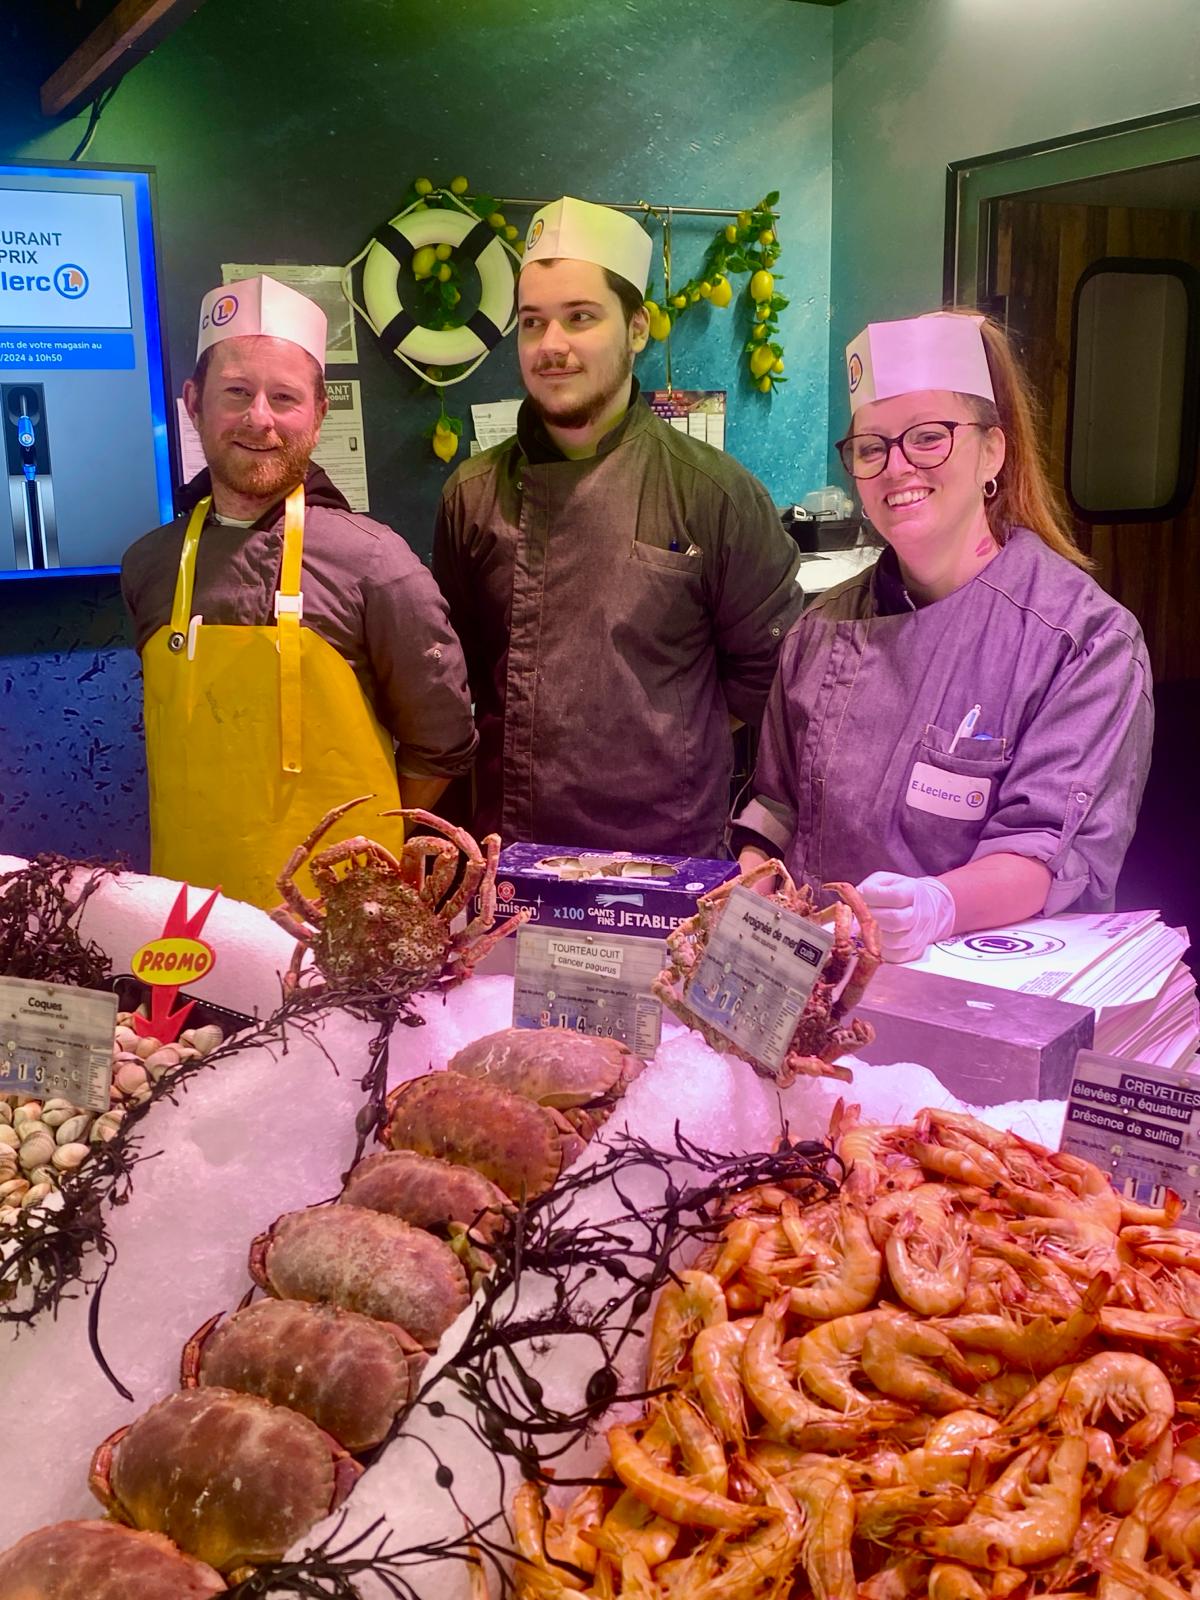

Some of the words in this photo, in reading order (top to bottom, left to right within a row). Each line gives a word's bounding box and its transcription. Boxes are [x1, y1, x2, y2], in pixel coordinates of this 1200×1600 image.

[0, 249, 38, 264] PRIX
[16, 340, 28, 349] de
[28, 341, 53, 349] votre
[54, 341, 90, 352] magasin
[35, 353, 63, 362] 10h50
[911, 780, 961, 803] E.Leclerc
[553, 907, 585, 920] x100
[587, 907, 616, 918] GANTS
[597, 917, 616, 927] FINS
[742, 911, 773, 936] Araignée
[772, 928, 783, 941] de
[783, 935, 799, 949] mer
[552, 943, 598, 957] TOURTEAU
[599, 949, 621, 959] CUIT
[138, 950, 208, 973] PROMO
[558, 956, 584, 967] cancer
[585, 962, 617, 974] pagurus
[28, 996, 62, 1011] Coques
[1124, 1078, 1200, 1106] CREVETTES
[1073, 1083, 1118, 1103] élevées
[1119, 1096, 1135, 1107] en
[1137, 1099, 1191, 1119] équateur
[1072, 1108, 1124, 1130] présence
[1127, 1122, 1142, 1135] de
[1144, 1127, 1180, 1145] sulfite
